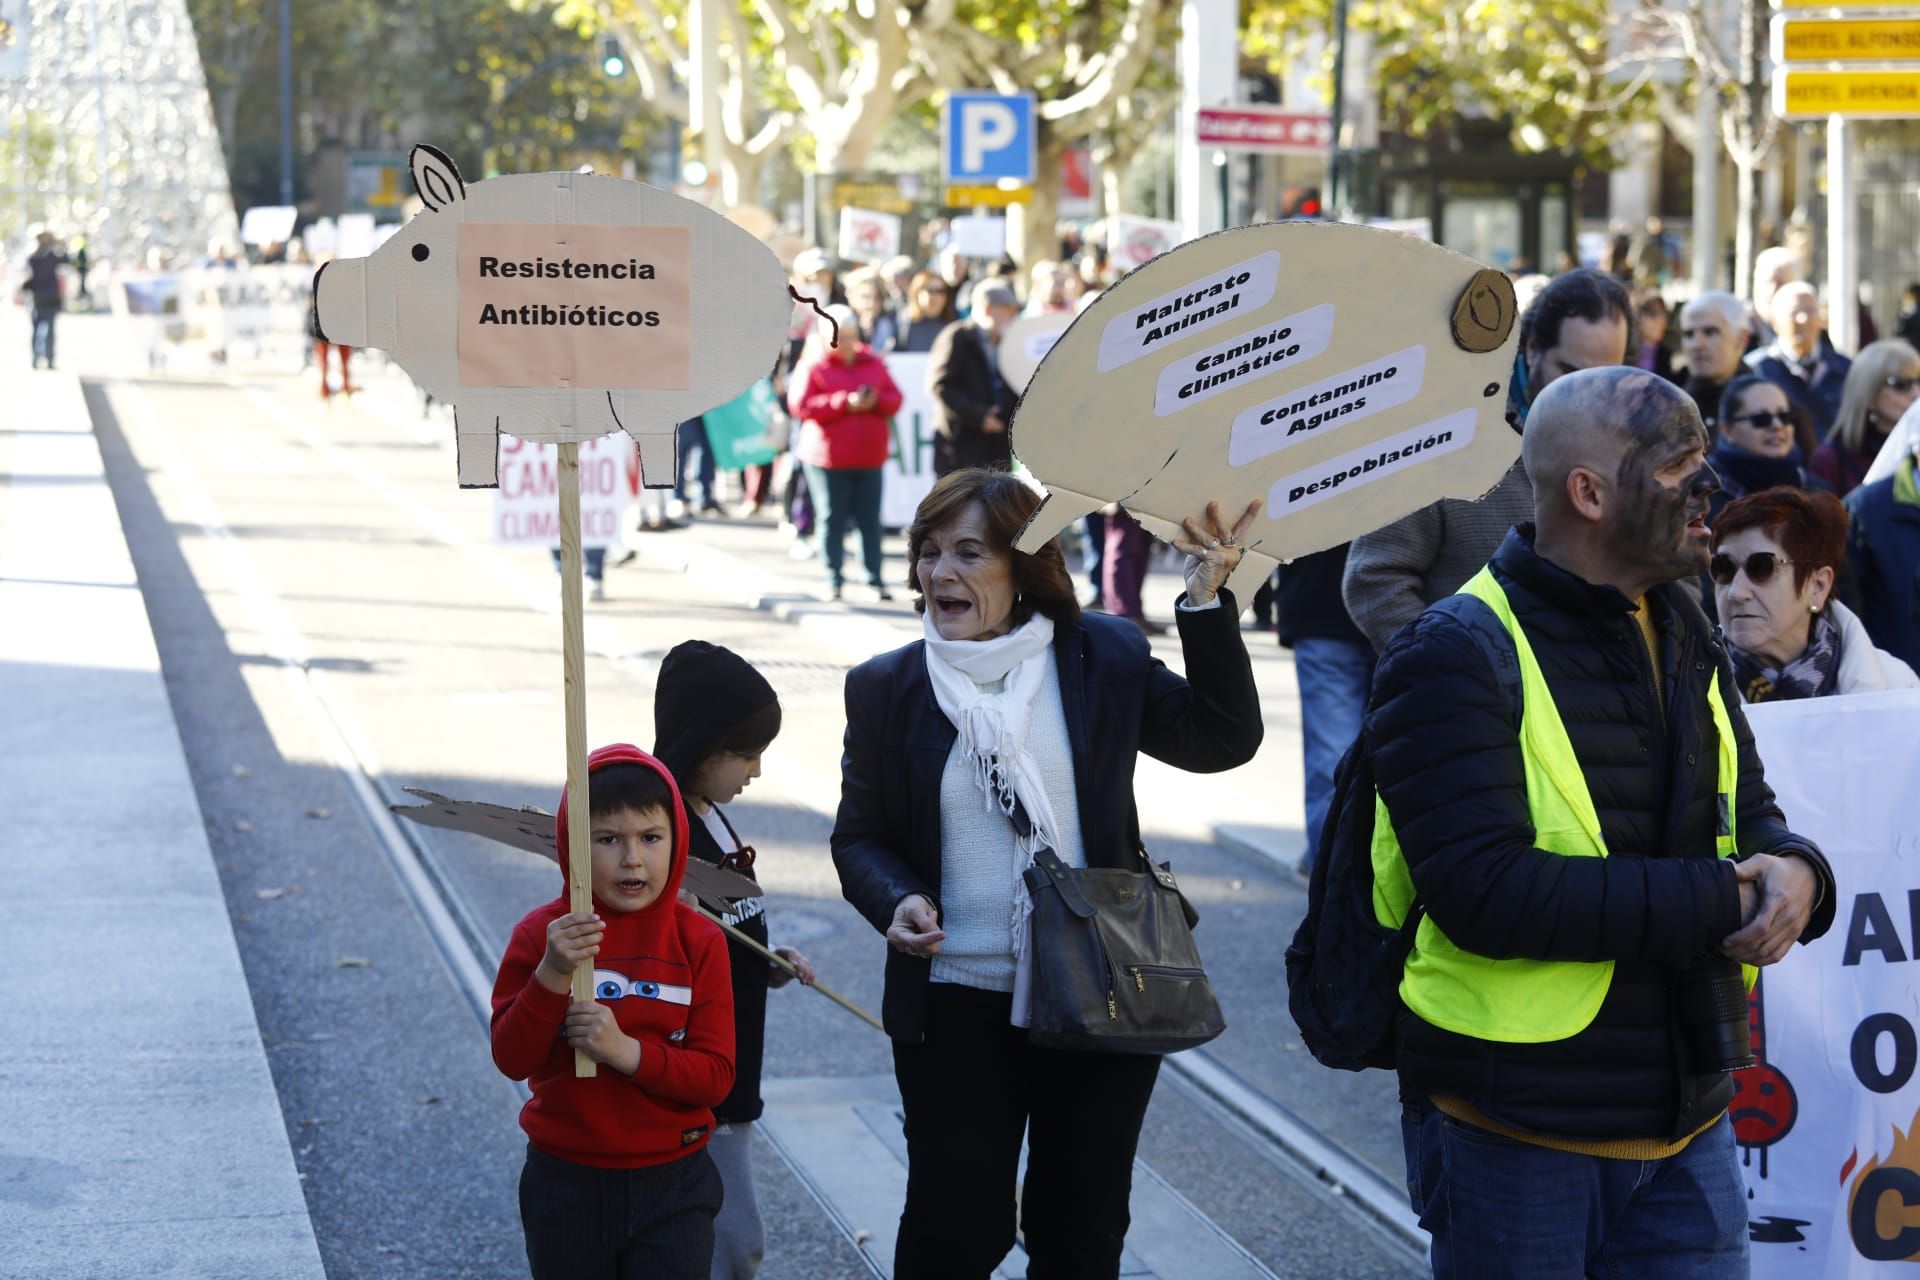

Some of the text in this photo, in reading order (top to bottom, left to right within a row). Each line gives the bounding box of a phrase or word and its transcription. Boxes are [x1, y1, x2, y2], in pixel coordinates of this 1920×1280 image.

[962, 102, 1018, 172] P
[479, 256, 656, 280] Resistencia
[478, 303, 661, 327] Antibióticos
[1135, 271, 1251, 330] Maltrato
[1141, 293, 1240, 346] Animal
[1177, 344, 1300, 399] Climático
[1195, 327, 1292, 373] Cambio
[1260, 366, 1398, 426] Contamino
[1286, 396, 1367, 437] Aguas
[1288, 430, 1453, 503] Despoblación
